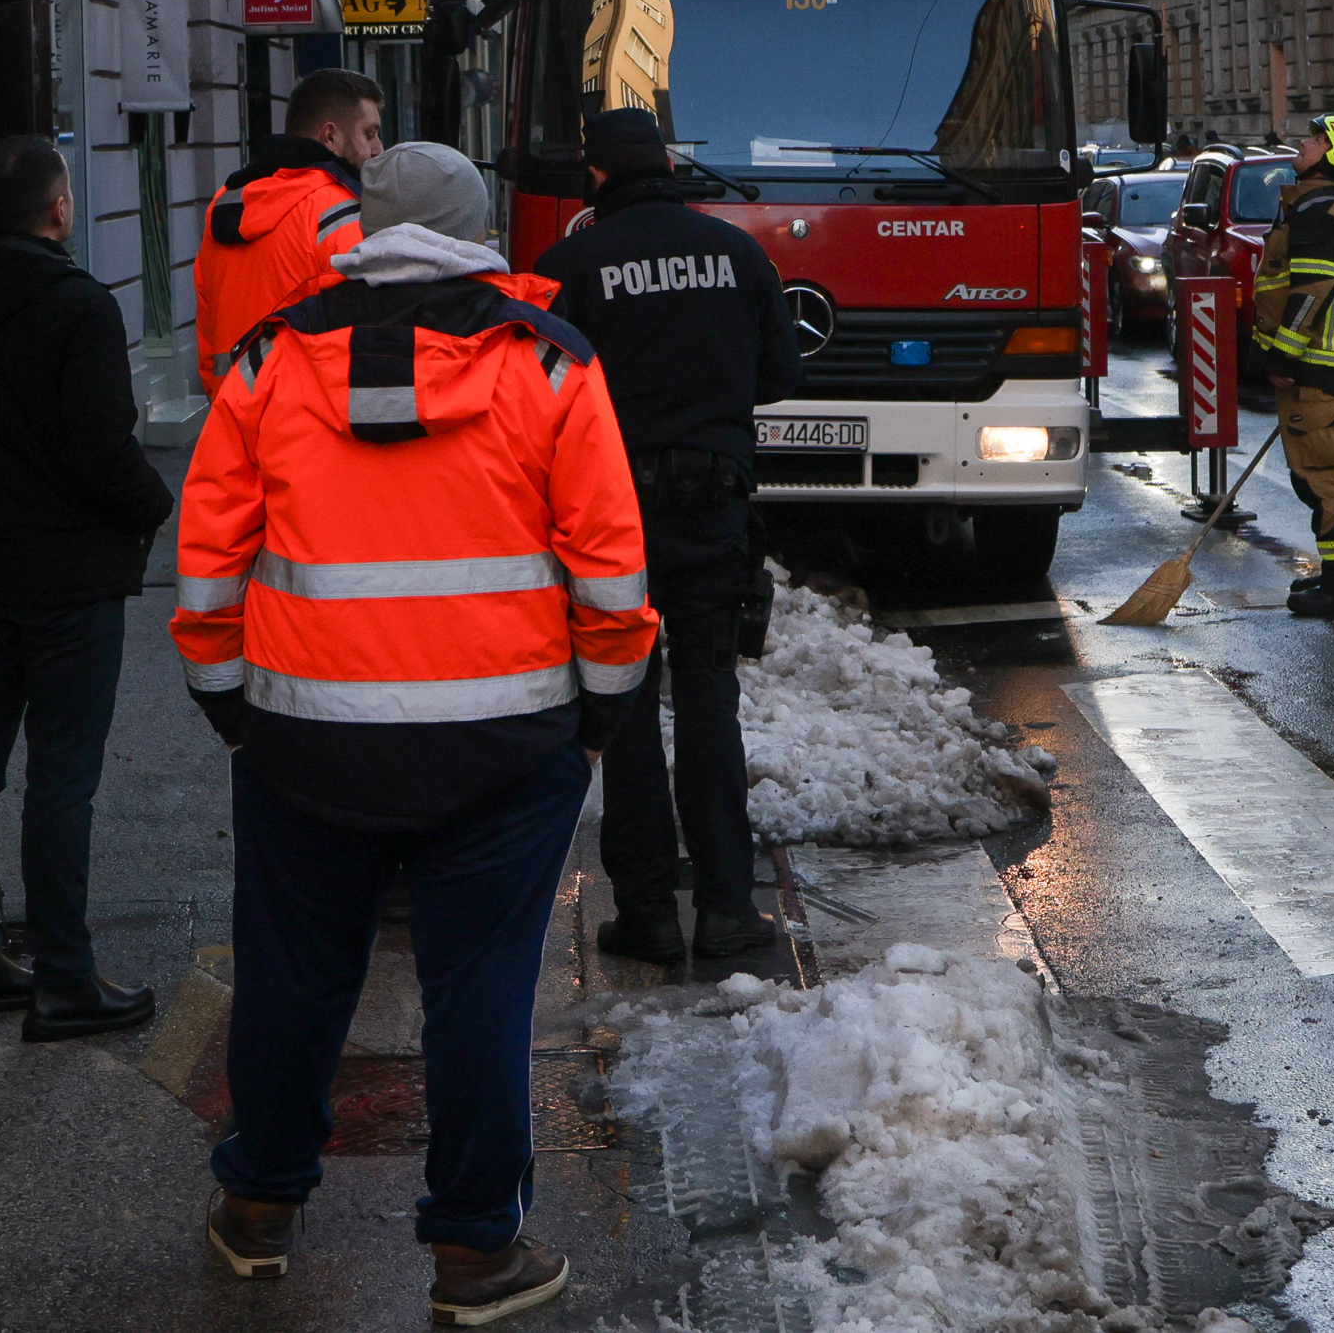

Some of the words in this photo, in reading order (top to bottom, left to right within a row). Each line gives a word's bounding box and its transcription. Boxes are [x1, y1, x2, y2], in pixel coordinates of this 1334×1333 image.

[248, 5, 279, 13] Julius
[281, 4, 308, 12] Meinl
[362, 25, 398, 35] POINT
[145, 0, 161, 83] A'MARIE
[877, 221, 965, 237] CENTAR
[600, 255, 737, 300] POLICIJA
